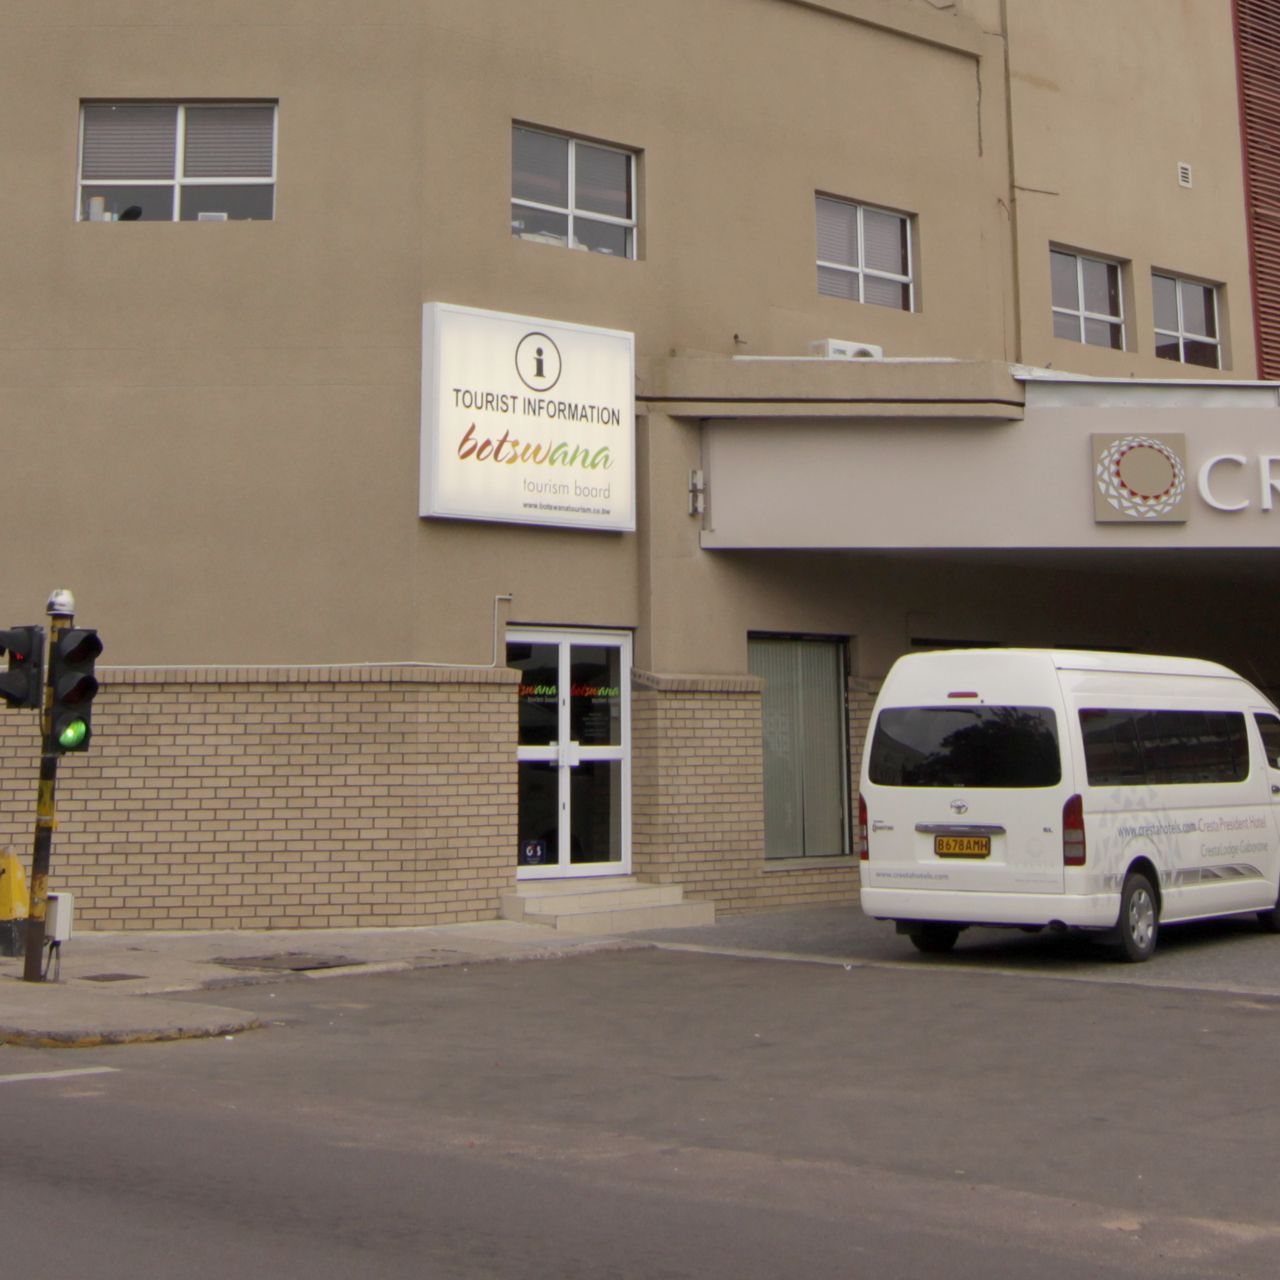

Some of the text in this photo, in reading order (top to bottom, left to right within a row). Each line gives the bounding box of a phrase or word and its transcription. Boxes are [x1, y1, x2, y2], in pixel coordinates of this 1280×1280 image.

[452, 388, 620, 426] TOURIST INFORMATION
[457, 422, 614, 470] botswana
[523, 478, 611, 499] tourism board
[937, 838, 988, 852] B678AMH
